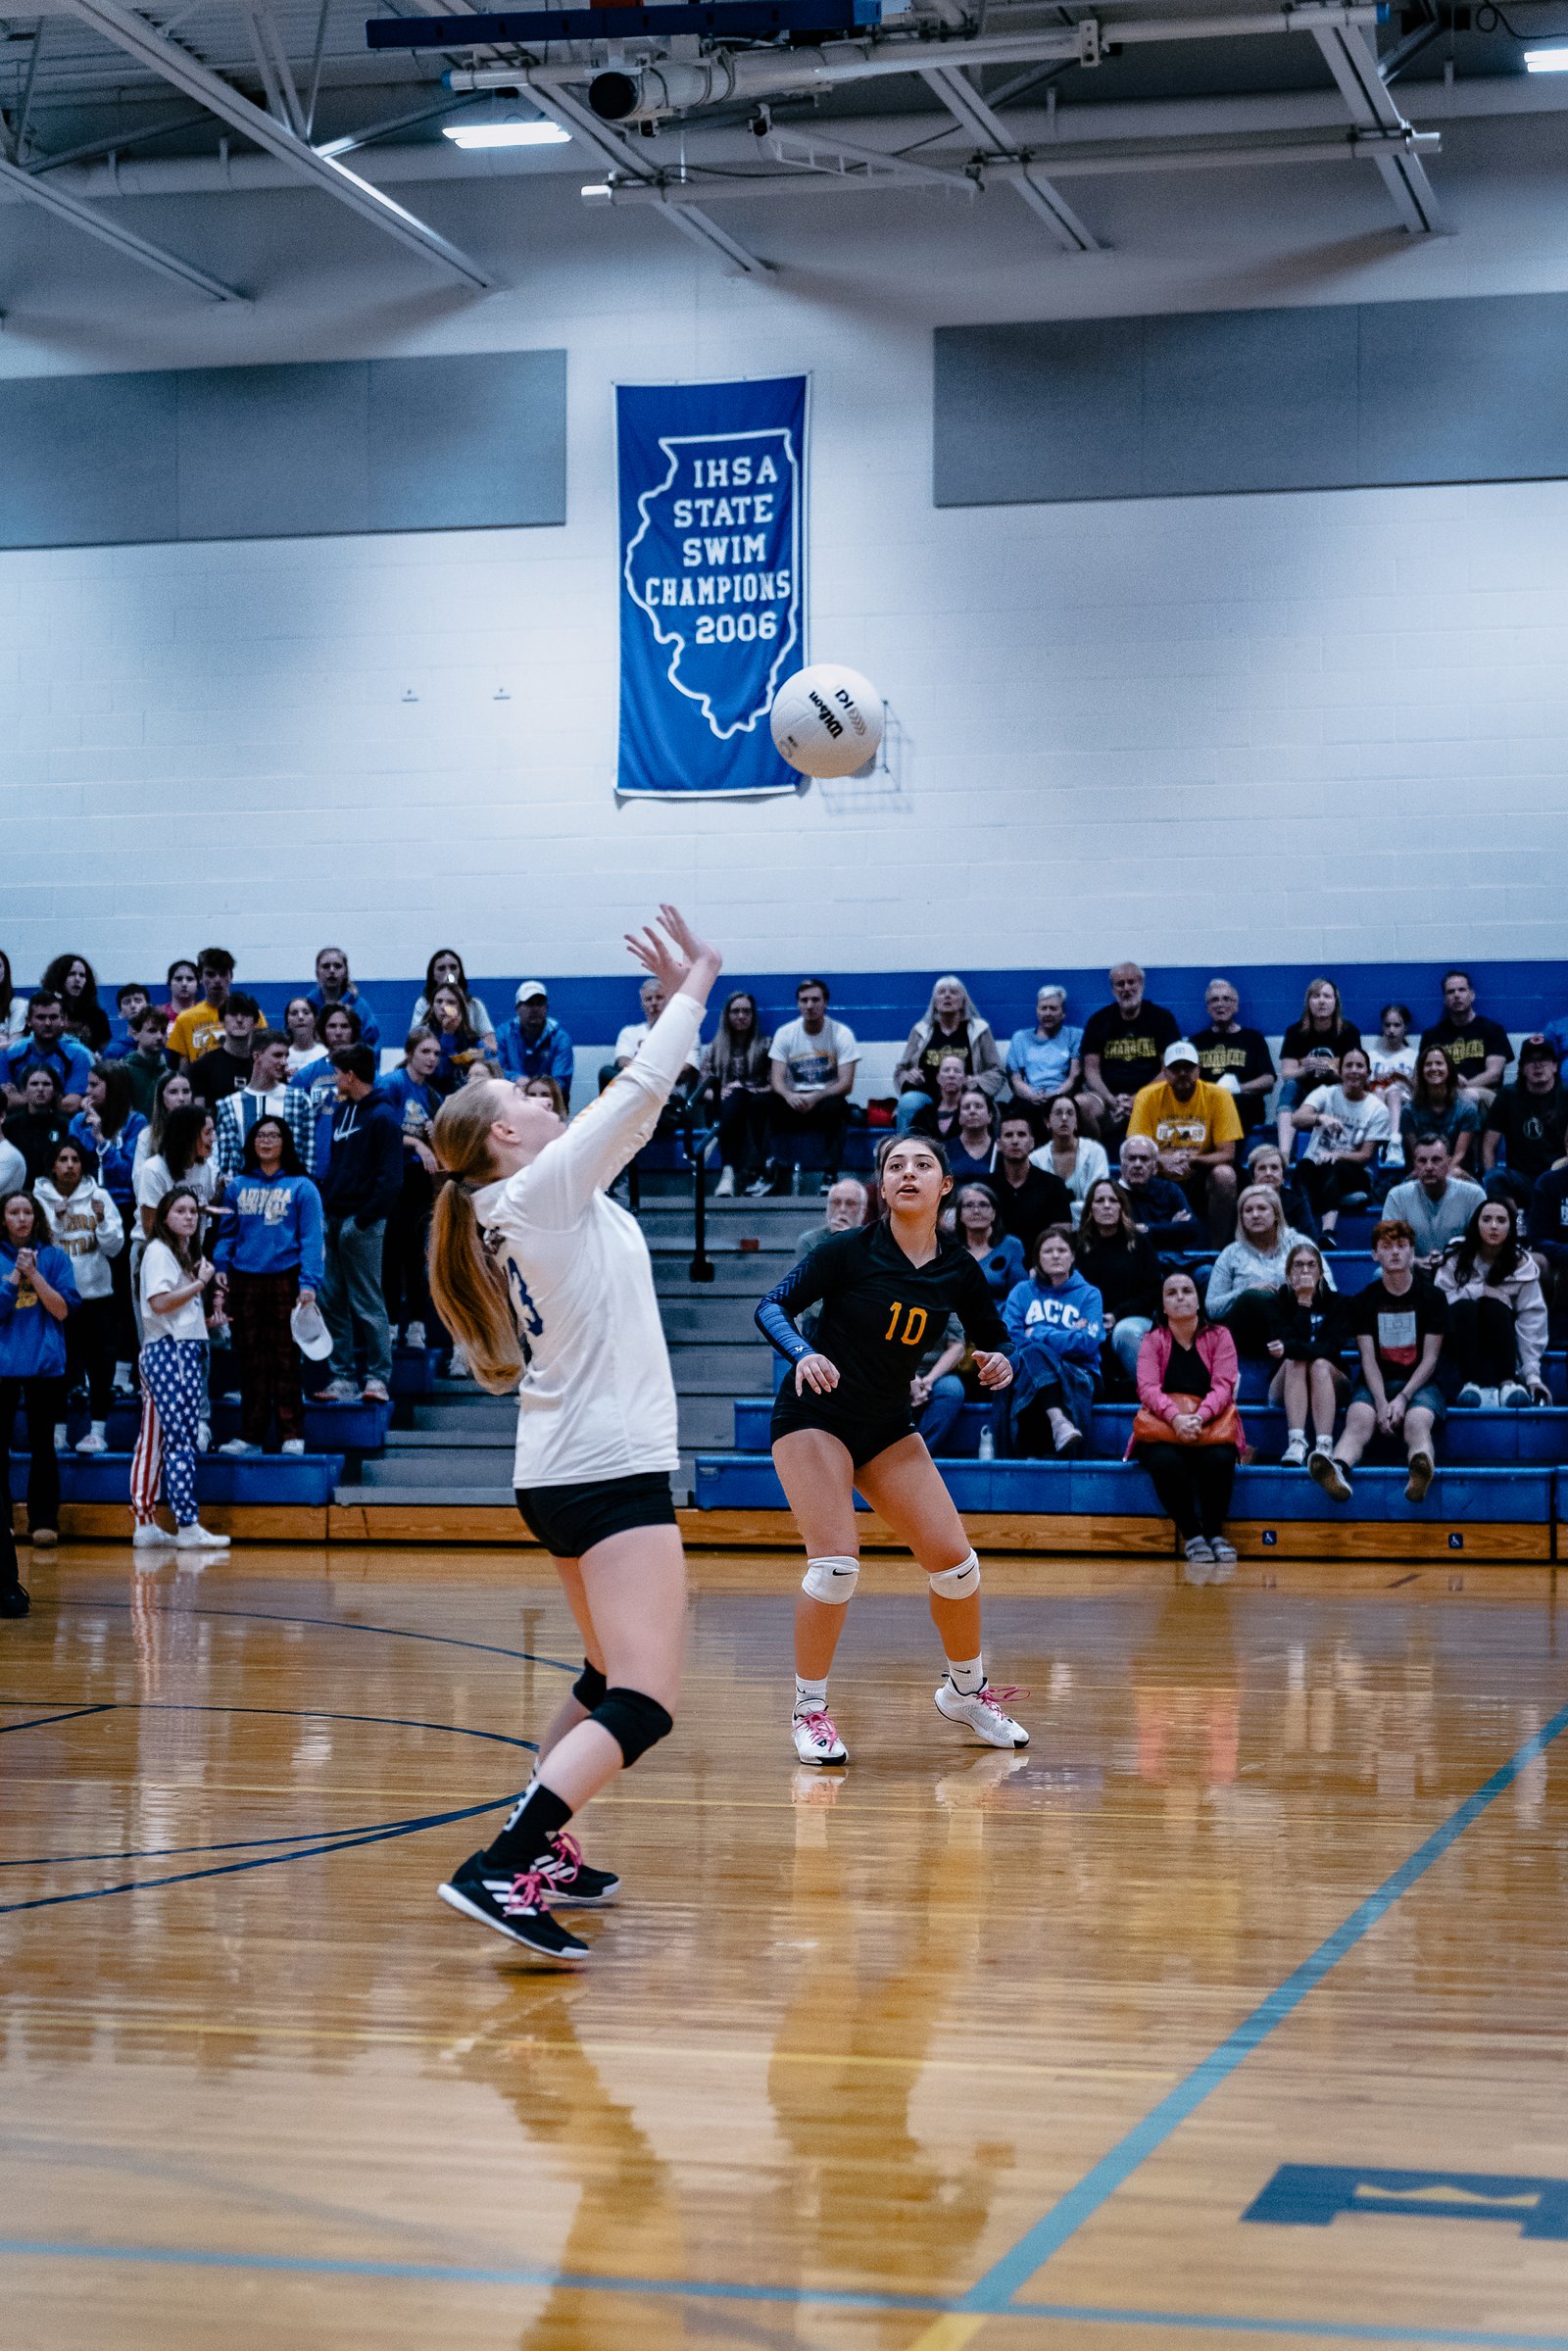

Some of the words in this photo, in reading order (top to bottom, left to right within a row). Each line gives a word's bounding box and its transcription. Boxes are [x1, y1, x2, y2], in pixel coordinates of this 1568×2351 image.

[693, 456, 778, 489] IHSA
[673, 493, 774, 528] STATE
[682, 533, 766, 567] SWIM
[645, 569, 792, 607] CHAMPIONS
[695, 612, 778, 645] 2006
[808, 690, 844, 740] Wilson
[885, 1301, 928, 1346] 10
[1025, 1298, 1080, 1331] ACC
